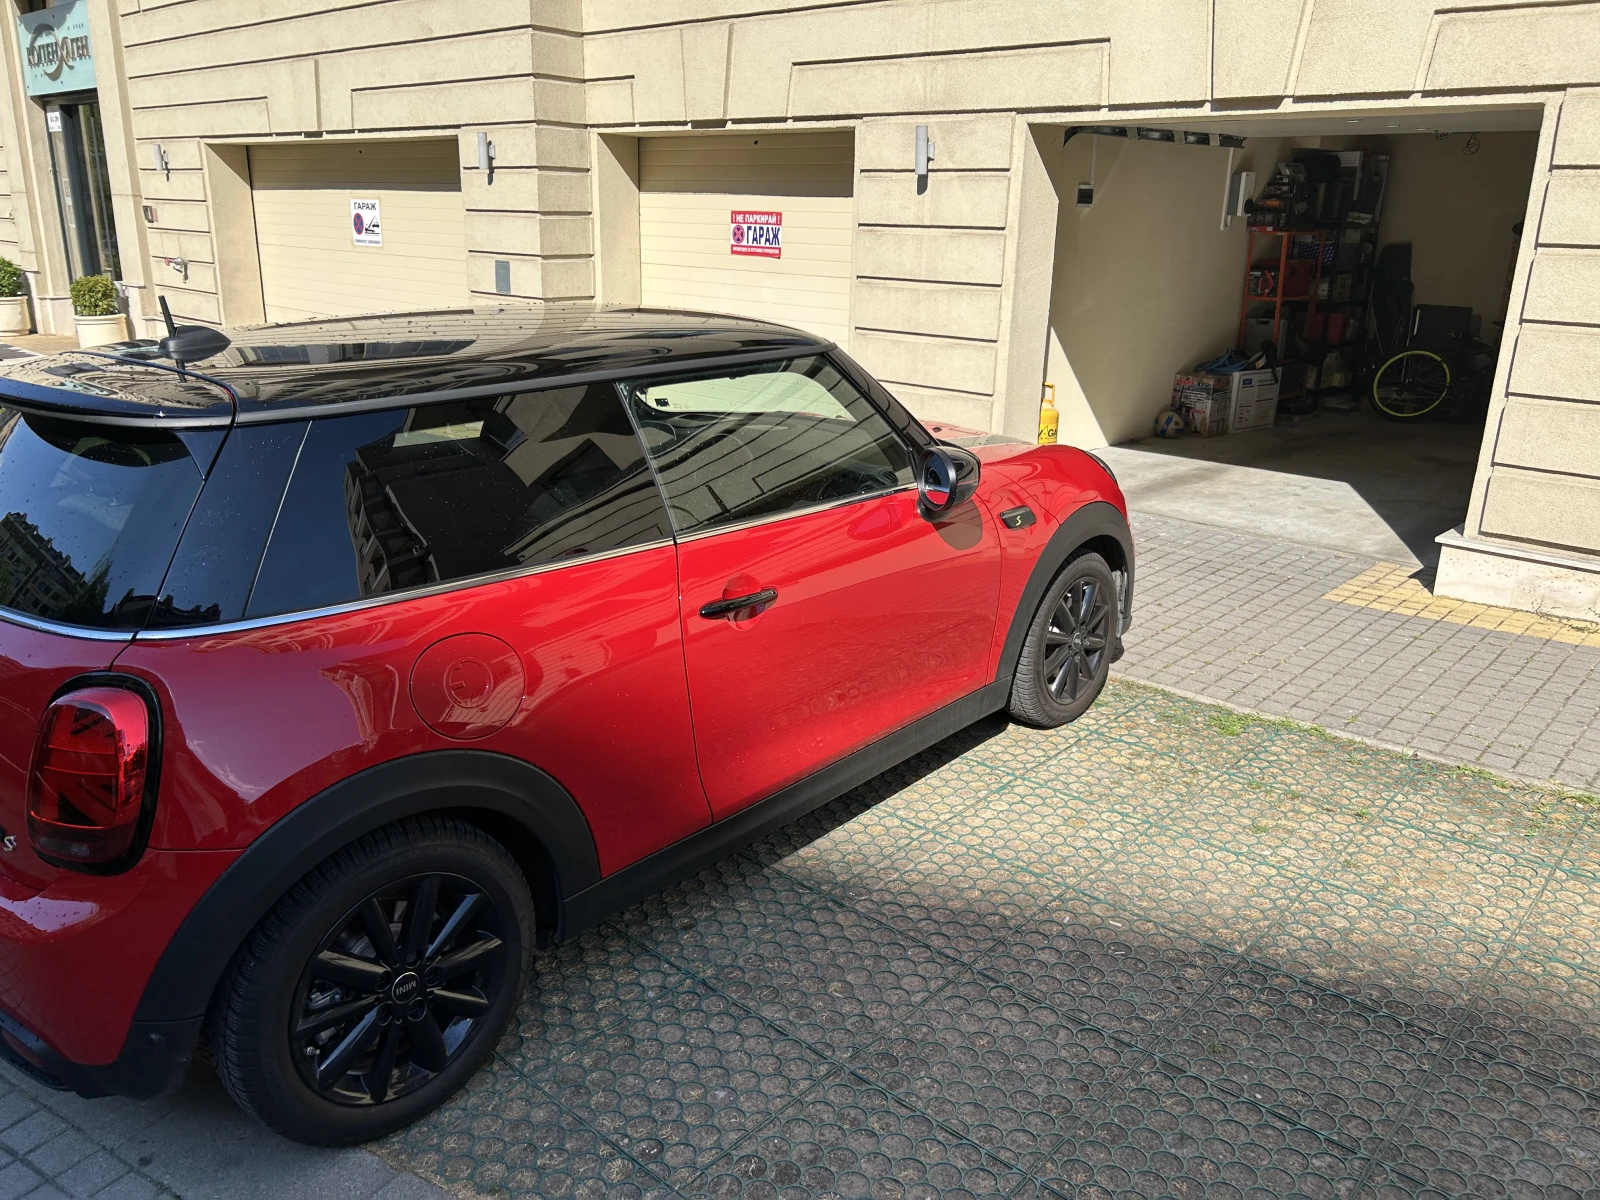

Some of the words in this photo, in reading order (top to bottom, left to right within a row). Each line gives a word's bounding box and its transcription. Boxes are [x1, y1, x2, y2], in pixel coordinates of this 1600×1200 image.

[353, 202, 377, 211] ГАРАЖ
[736, 214, 744, 223] НЕ
[745, 213, 776, 224] ПАРКИРАЙ
[746, 225, 780, 245] ГАРАЖ
[396, 980, 417, 996] MINI
